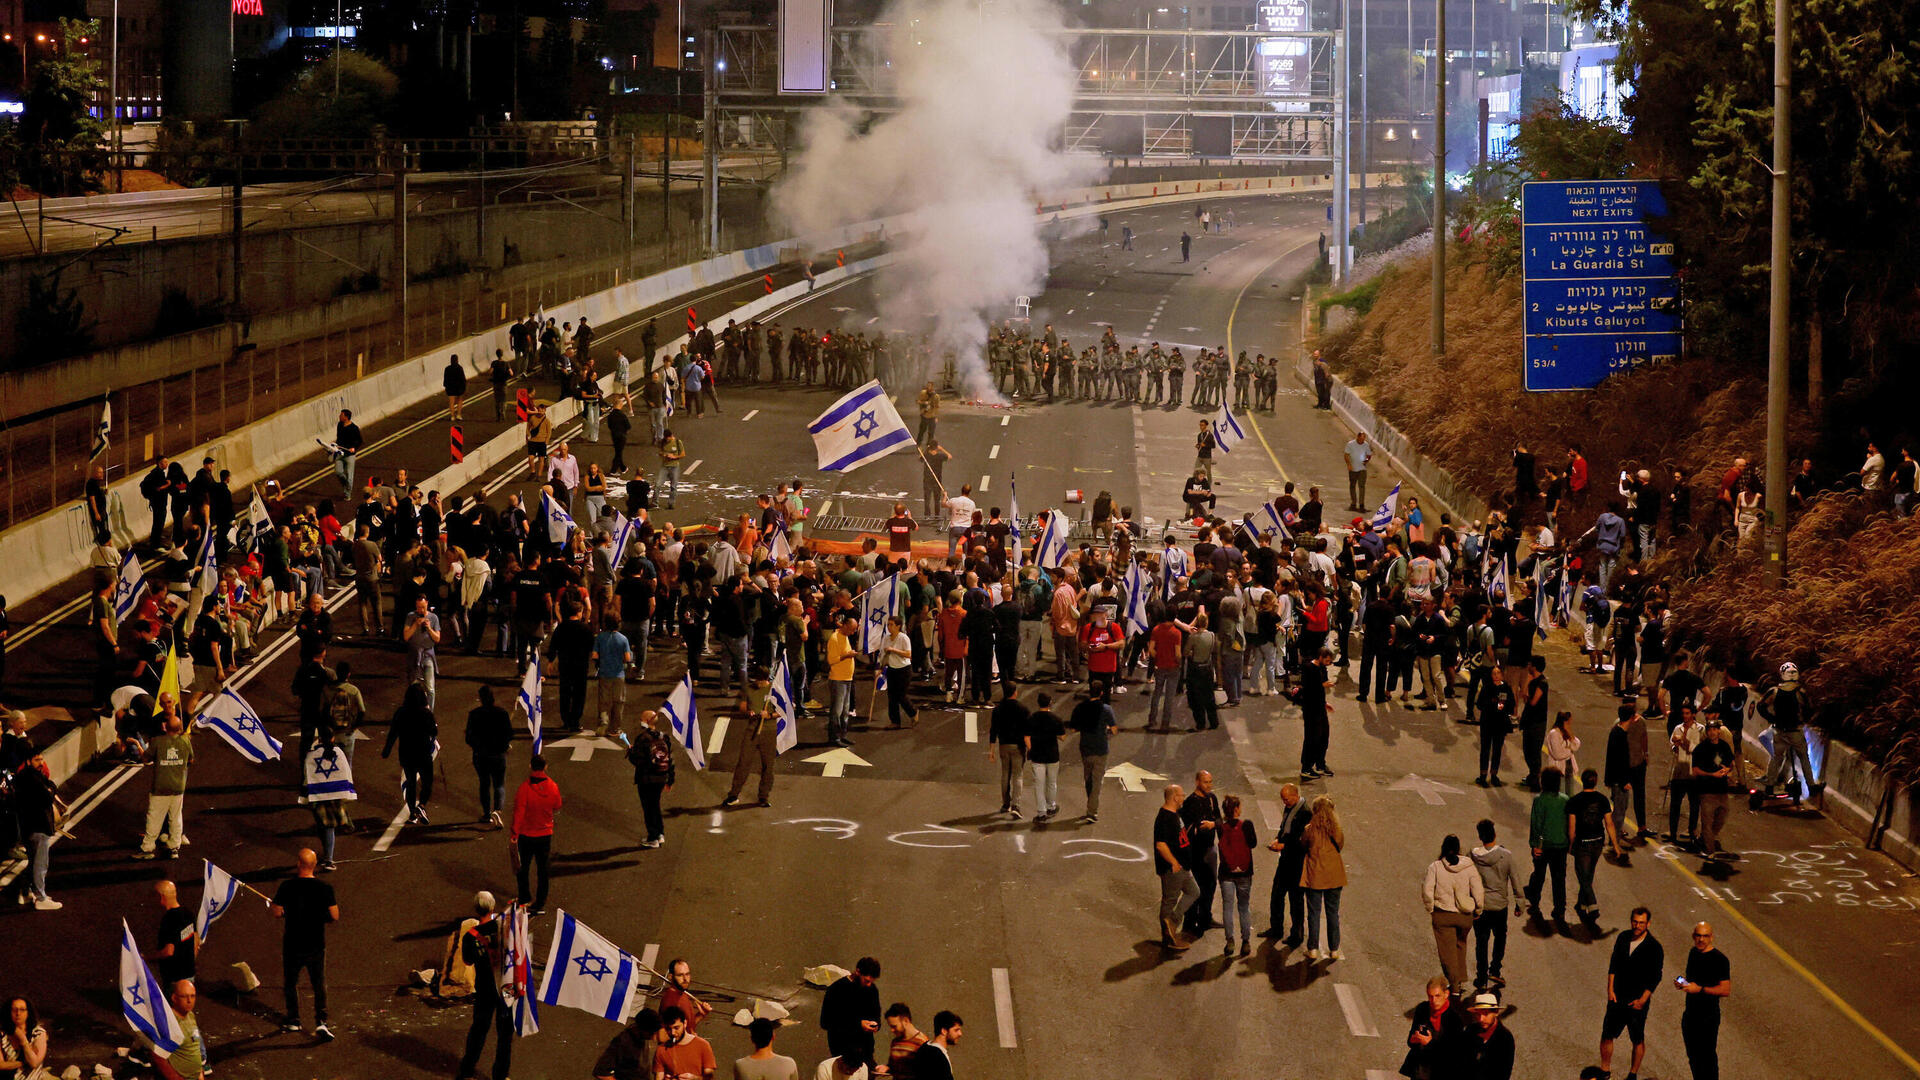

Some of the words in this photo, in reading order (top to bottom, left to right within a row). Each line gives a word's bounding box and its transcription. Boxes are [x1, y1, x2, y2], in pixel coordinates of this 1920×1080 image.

[1287, 5, 1304, 16] של
[1265, 17, 1299, 27] במחיר
[1566, 187, 1595, 196] הבאות
[1600, 186, 1637, 195] היציאות
[1568, 197, 1597, 206] المقبلة
[1601, 196, 1637, 207] المخارج
[1572, 209, 1599, 217] NEXT
[1603, 208, 1633, 217] EXITS
[1549, 231, 1596, 242] גוורדיה
[1602, 229, 1619, 241] לה
[1624, 229, 1645, 240] רח'
[1531, 247, 1537, 256] 1
[1603, 245, 1610, 255] لا
[1617, 244, 1646, 257] شارع
[1663, 245, 1673, 254] 10
[1551, 260, 1567, 270] La
[1573, 259, 1624, 270] Guardia
[1630, 259, 1645, 269] St
[1567, 286, 1606, 297] גלויות
[1612, 286, 1646, 298] קיבוץ
[1532, 303, 1539, 312] 2
[1608, 300, 1646, 313] كيبوتس
[1545, 317, 1588, 327] Kibuts
[1594, 316, 1646, 328] Galuyot
[1615, 341, 1646, 353] חולון
[1533, 359, 1540, 368] 5
[1653, 844, 1858, 866] ישרל
